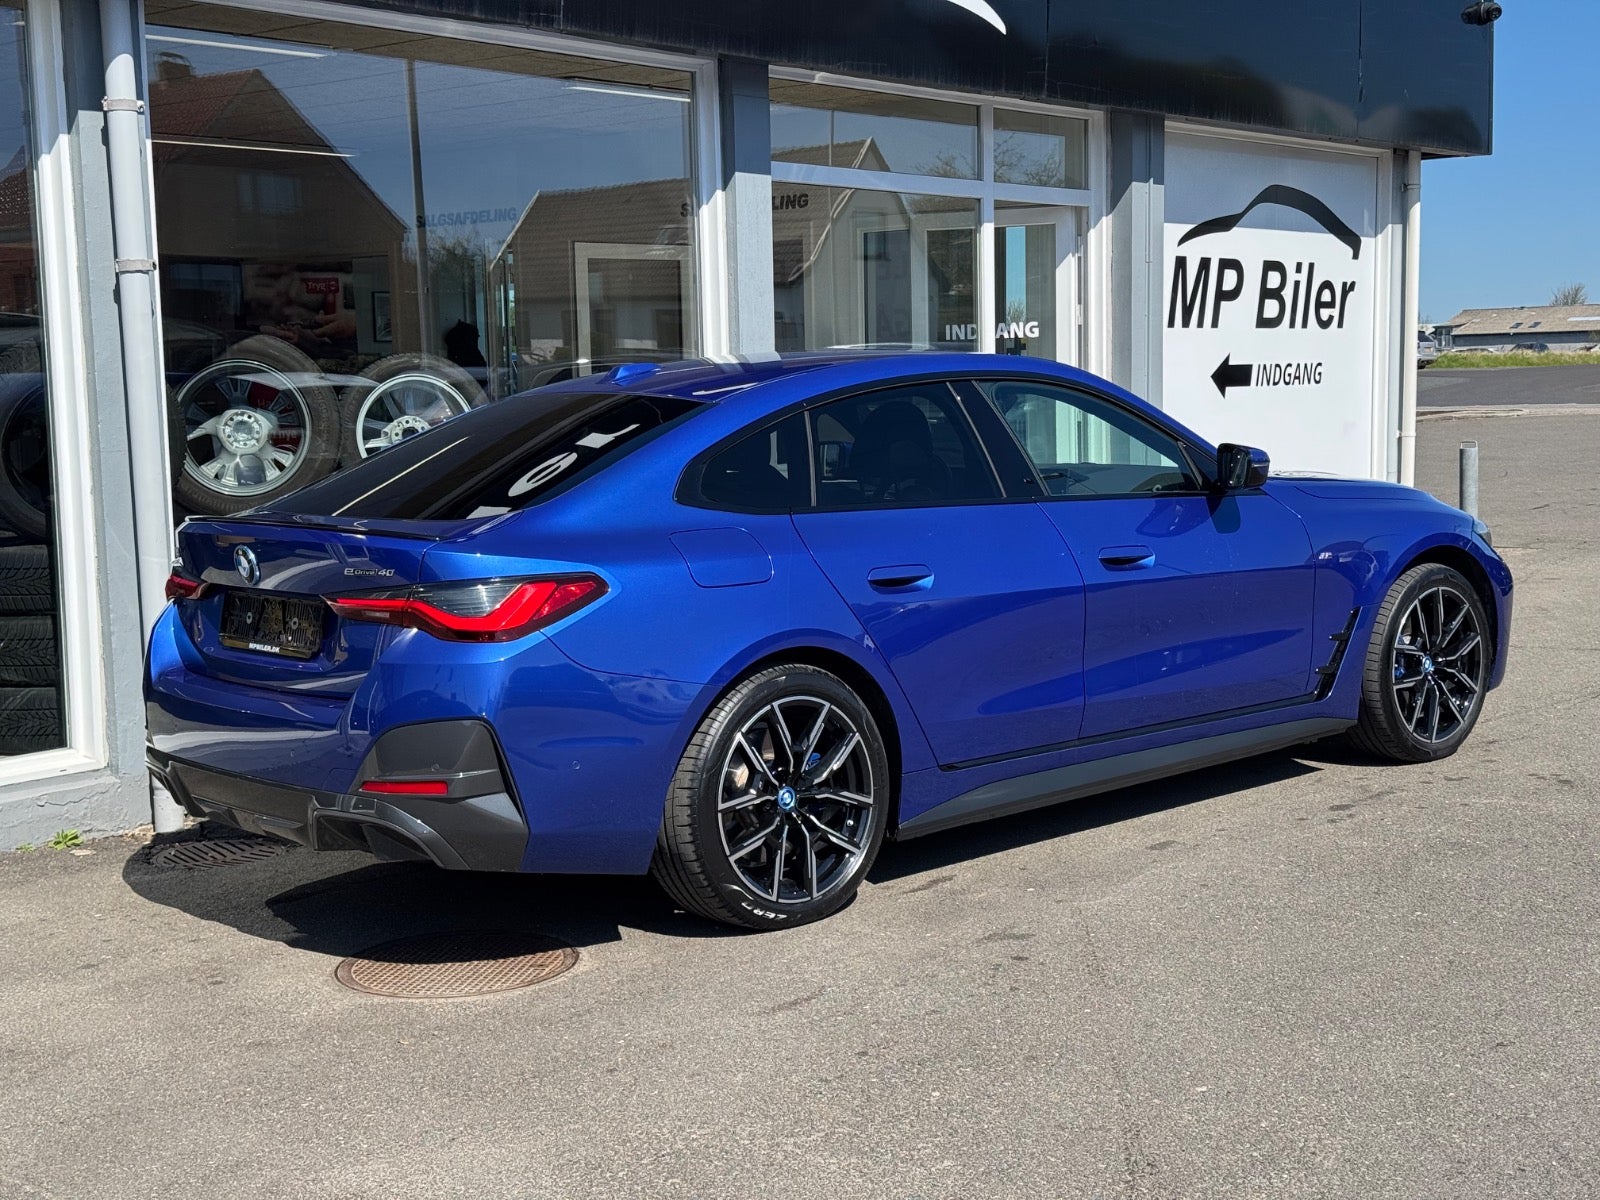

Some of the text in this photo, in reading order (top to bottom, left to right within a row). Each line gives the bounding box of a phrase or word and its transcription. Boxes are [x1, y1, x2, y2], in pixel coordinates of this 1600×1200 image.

[416, 207, 517, 229] SALGSAFDELING
[1167, 255, 1356, 330] MP Biler
[945, 321, 1040, 341] INDANG
[1255, 362, 1323, 387] INDGANG
